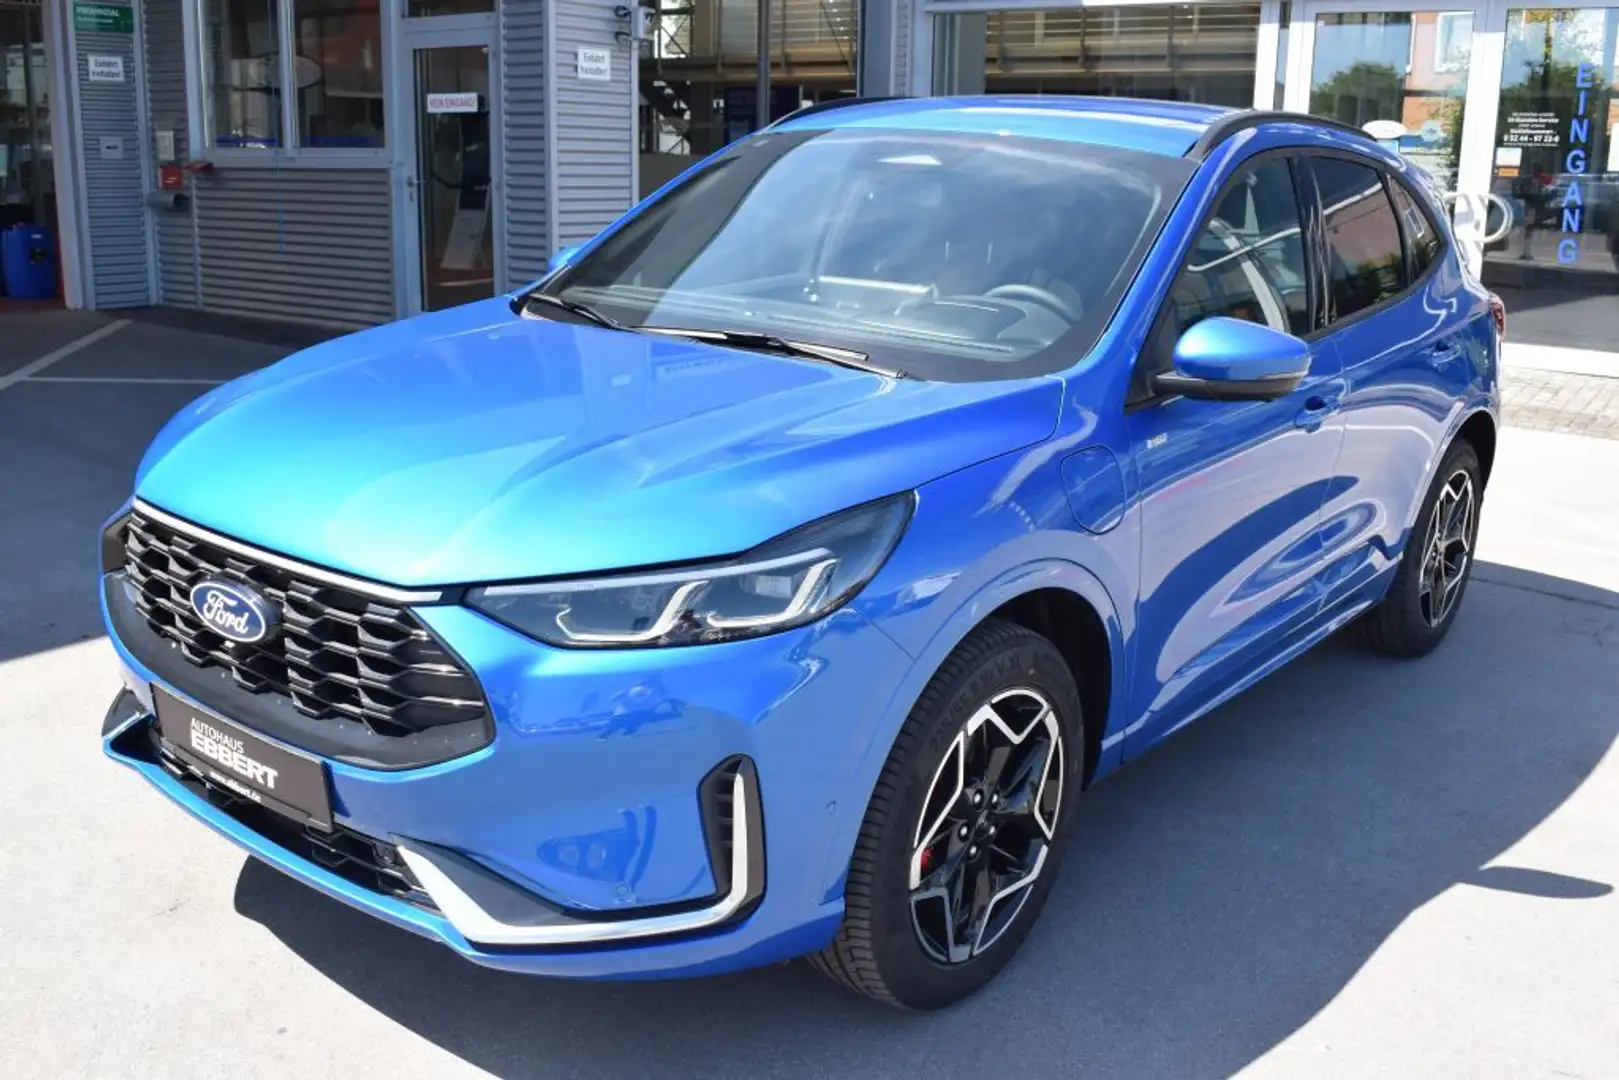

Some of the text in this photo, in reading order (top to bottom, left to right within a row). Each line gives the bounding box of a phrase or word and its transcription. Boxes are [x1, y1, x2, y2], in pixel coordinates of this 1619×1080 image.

[1557, 61, 1595, 263] EINGANG
[203, 590, 250, 634] Ford
[190, 717, 245, 753] AUTOHAUS
[190, 729, 279, 789] EBBERT
